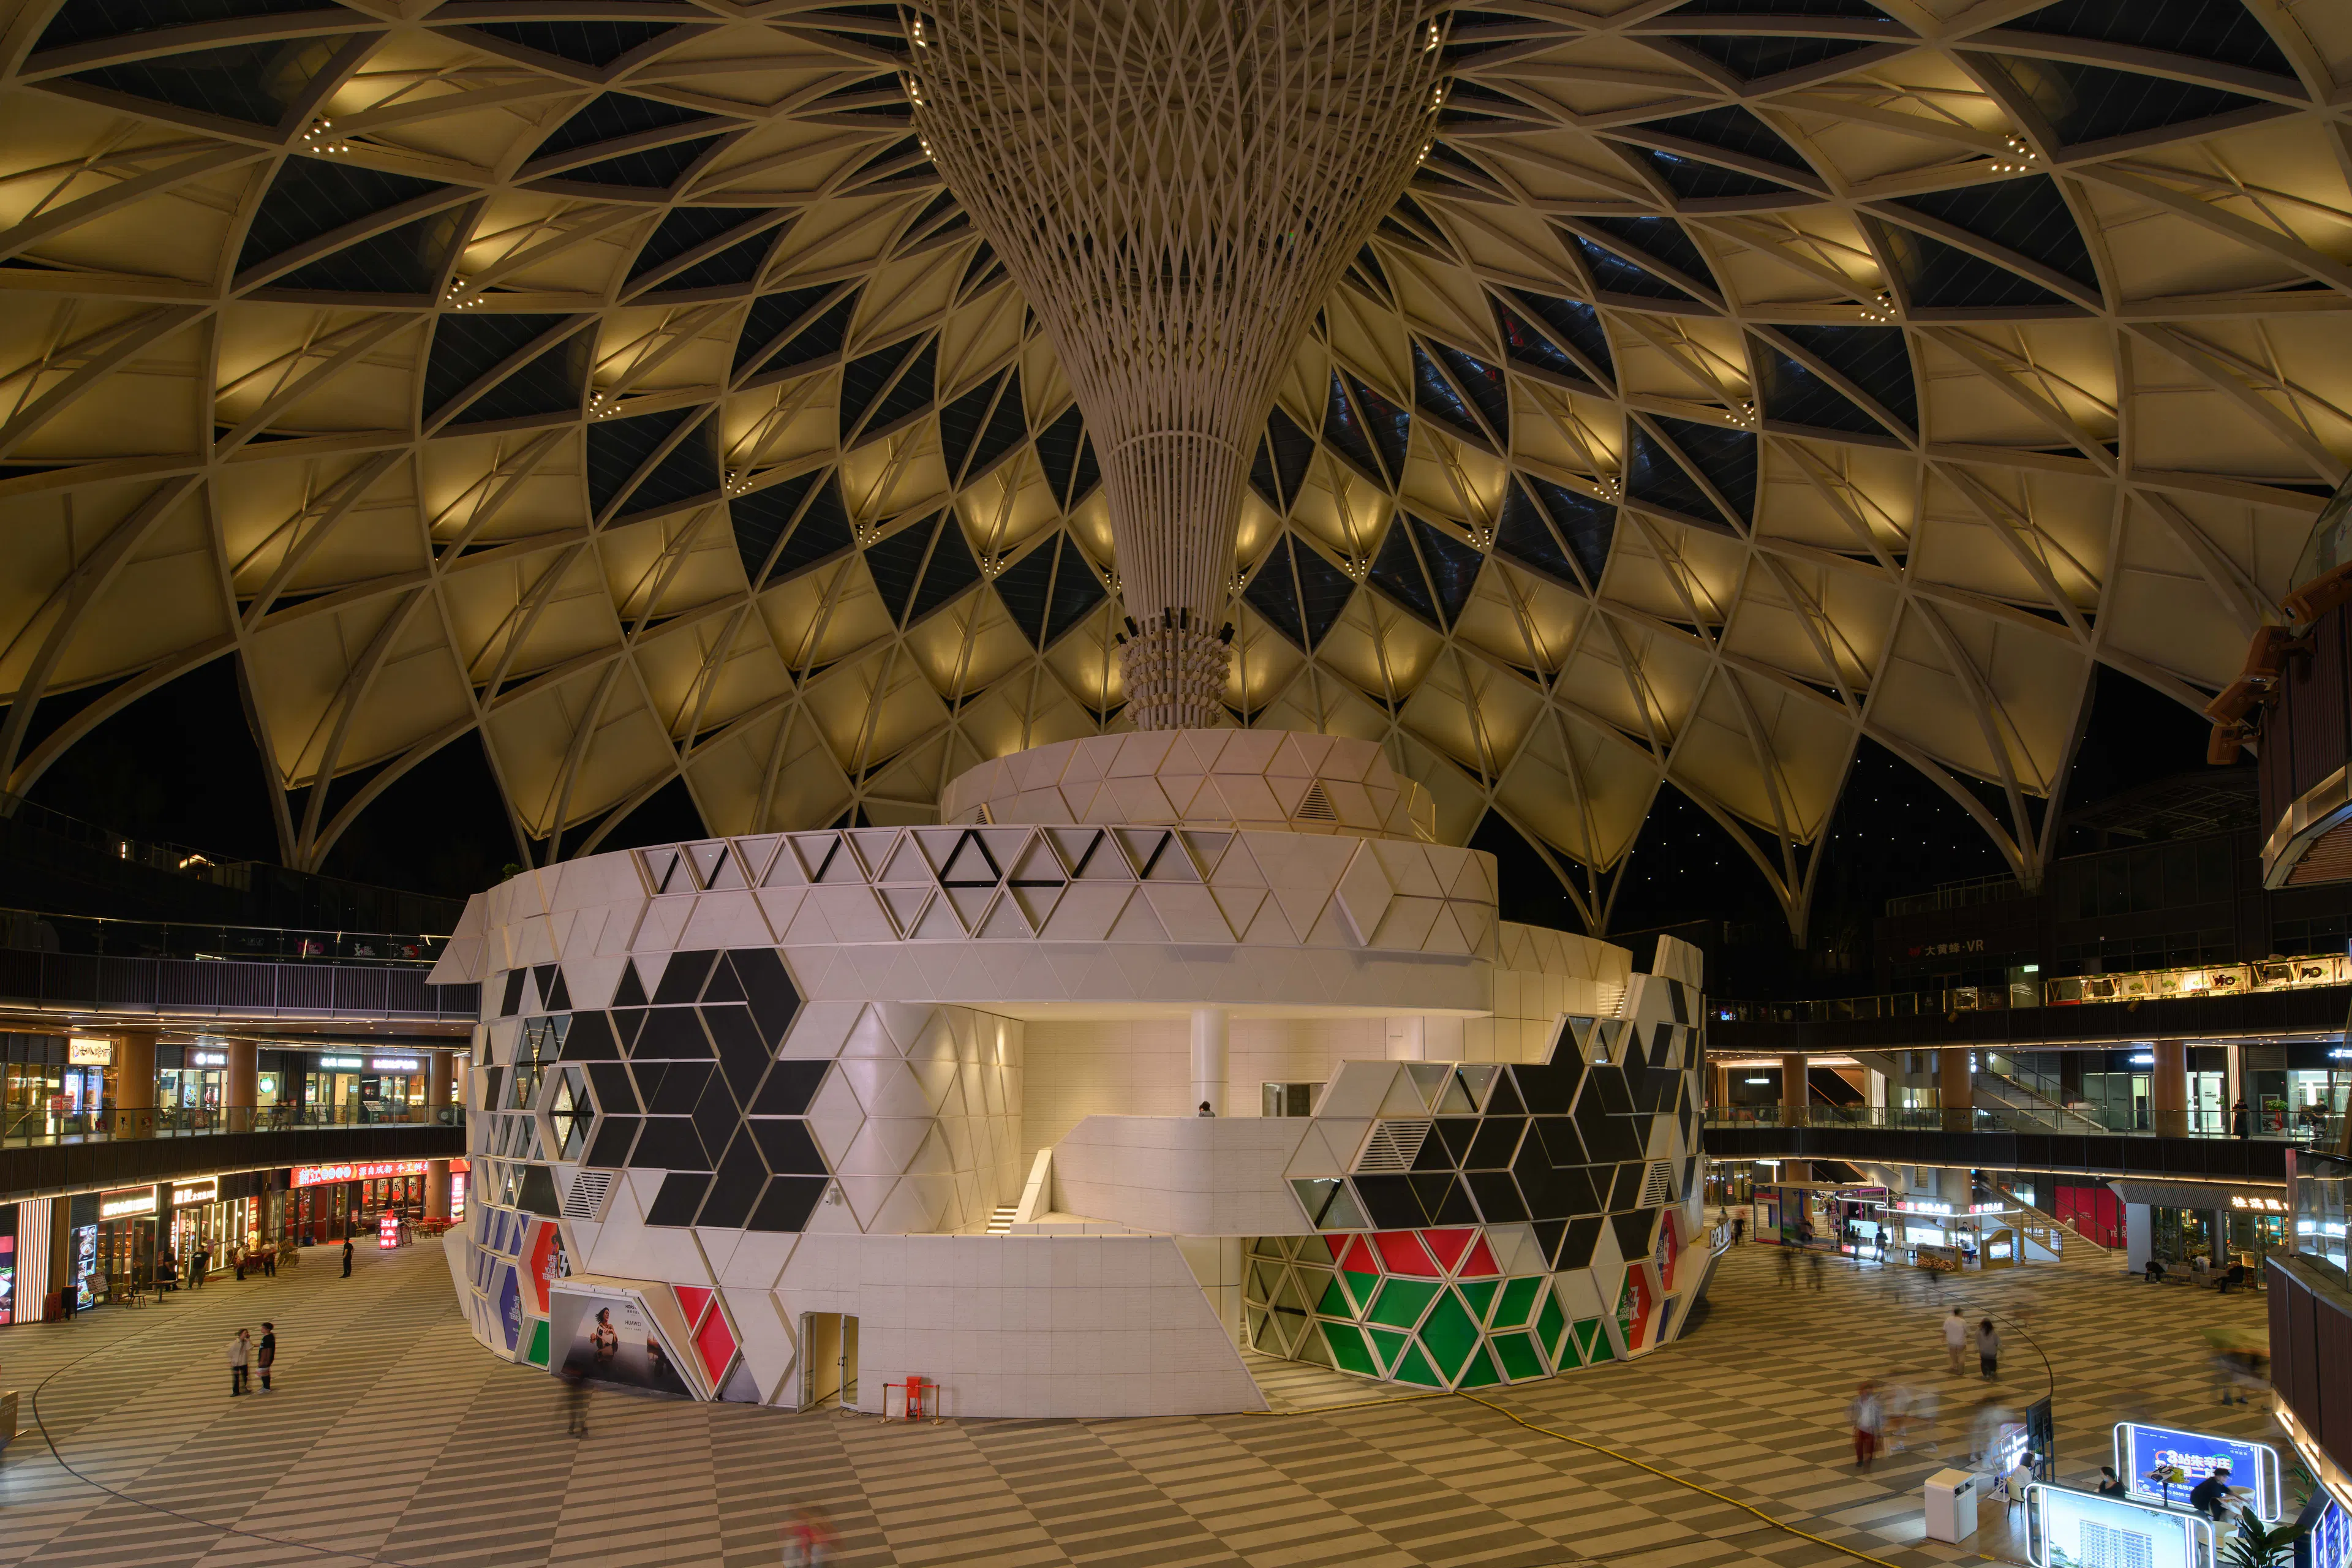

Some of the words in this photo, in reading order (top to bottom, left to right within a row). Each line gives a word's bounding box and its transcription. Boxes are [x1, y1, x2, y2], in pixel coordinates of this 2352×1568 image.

[358, 1164, 392, 1175] 源自成都
[1619, 1306, 1629, 1315] YOUR
